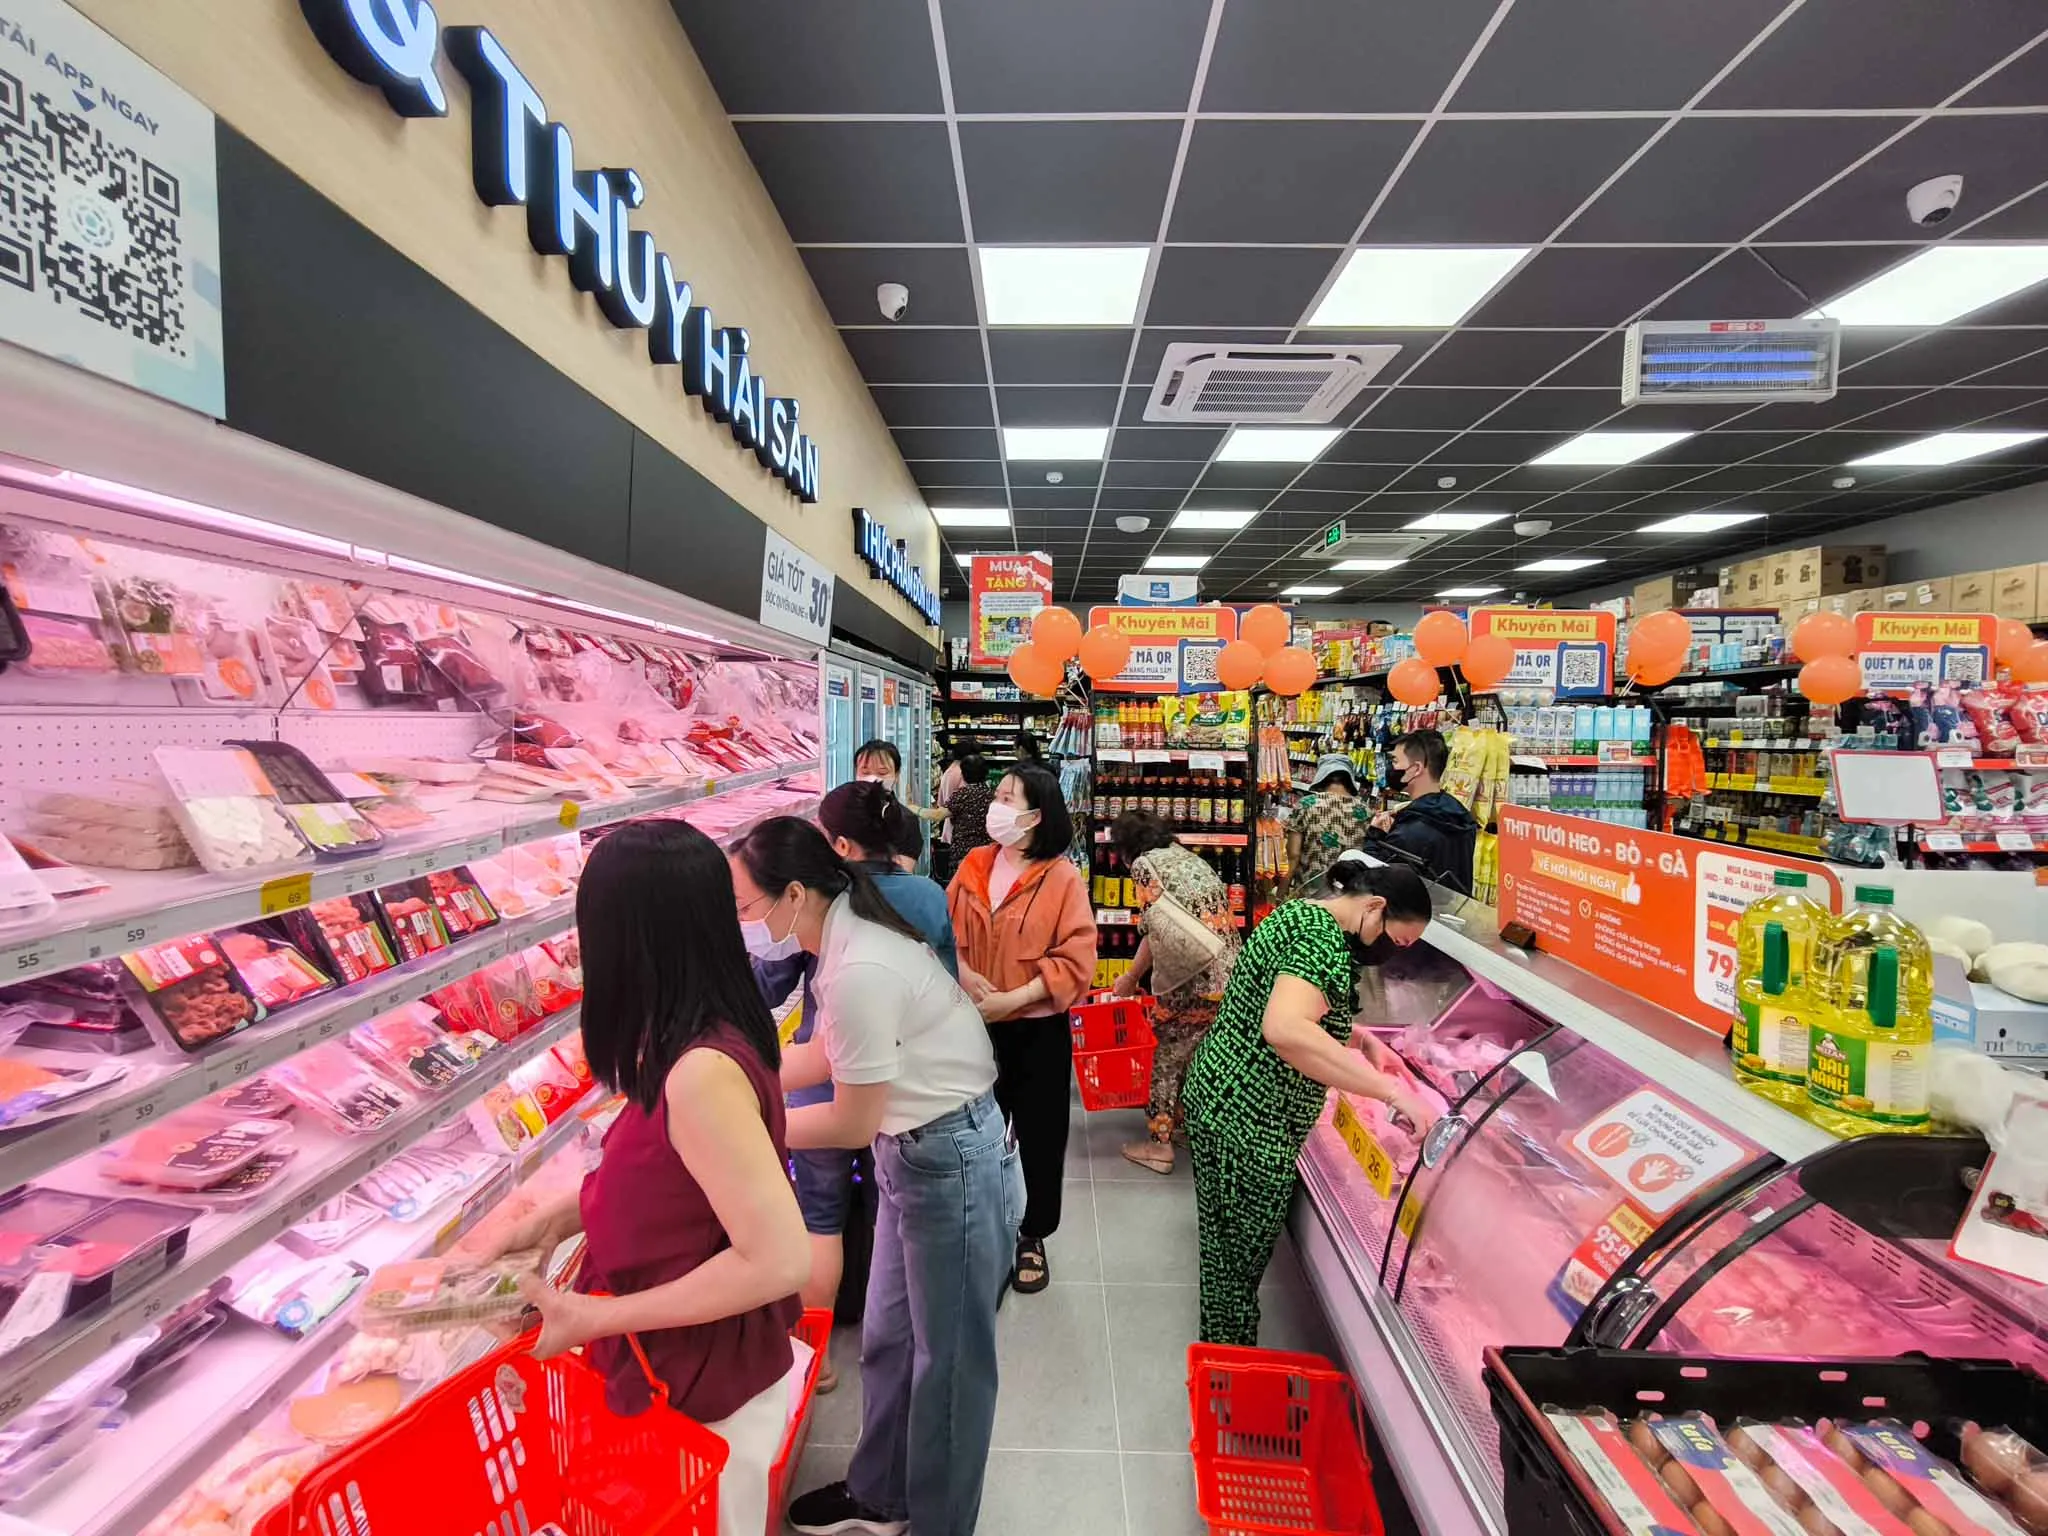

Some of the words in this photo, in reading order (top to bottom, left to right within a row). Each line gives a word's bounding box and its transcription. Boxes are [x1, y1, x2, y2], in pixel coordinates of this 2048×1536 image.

[45, 52, 94, 91] APP
[100, 86, 160, 137] NGAY
[481, 28, 692, 363] THỦY
[704, 307, 766, 447] HẢI
[771, 399, 820, 502] SẢN
[863, 510, 890, 579] THỰC
[768, 551, 785, 586] GIÁ
[787, 558, 805, 595] TỐT
[989, 560, 1019, 573] MUA
[986, 575, 1026, 591] TẶNG
[1136, 648, 1153, 663] MÃ
[1157, 651, 1172, 664] QR
[1516, 651, 1532, 666] MÃ
[1536, 655, 1551, 668] QR
[1865, 654, 1896, 670] QUÉT
[1898, 654, 1914, 669] MÃ
[1919, 658, 1933, 671] QR
[1504, 817, 1531, 840] THỊT
[1534, 823, 1565, 847] TƯƠI
[1569, 832, 1600, 854] HEO
[1616, 839, 1641, 865] BÒ
[1659, 849, 1688, 877] GÀ
[127, 928, 145, 942] 59
[17, 953, 40, 968] 55
[234, 1060, 249, 1075] 97
[135, 1103, 154, 1120] 39
[1352, 1134, 1360, 1154] 10
